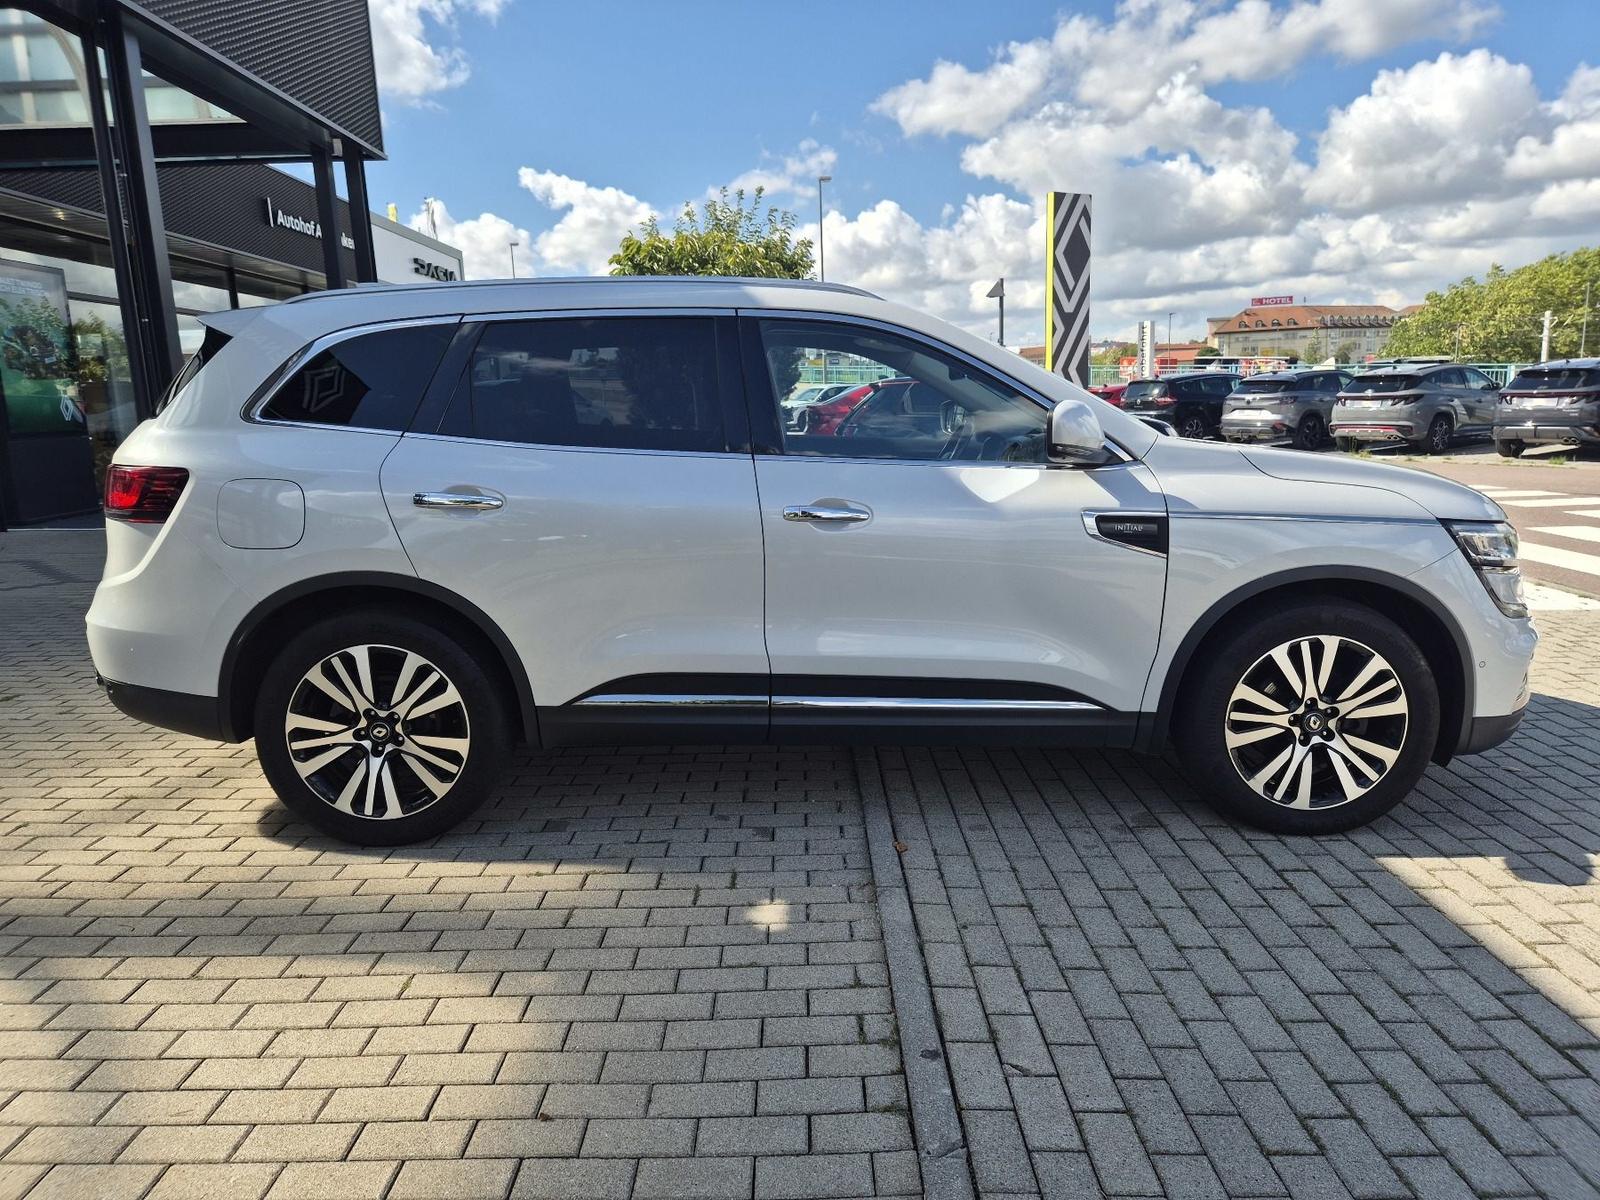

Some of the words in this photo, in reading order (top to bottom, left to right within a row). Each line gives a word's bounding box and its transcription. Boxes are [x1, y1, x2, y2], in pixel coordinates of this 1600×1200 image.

[277, 209, 315, 236] Autohof
[413, 257, 457, 282] DACIA
[1262, 297, 1292, 305] HOTEL
